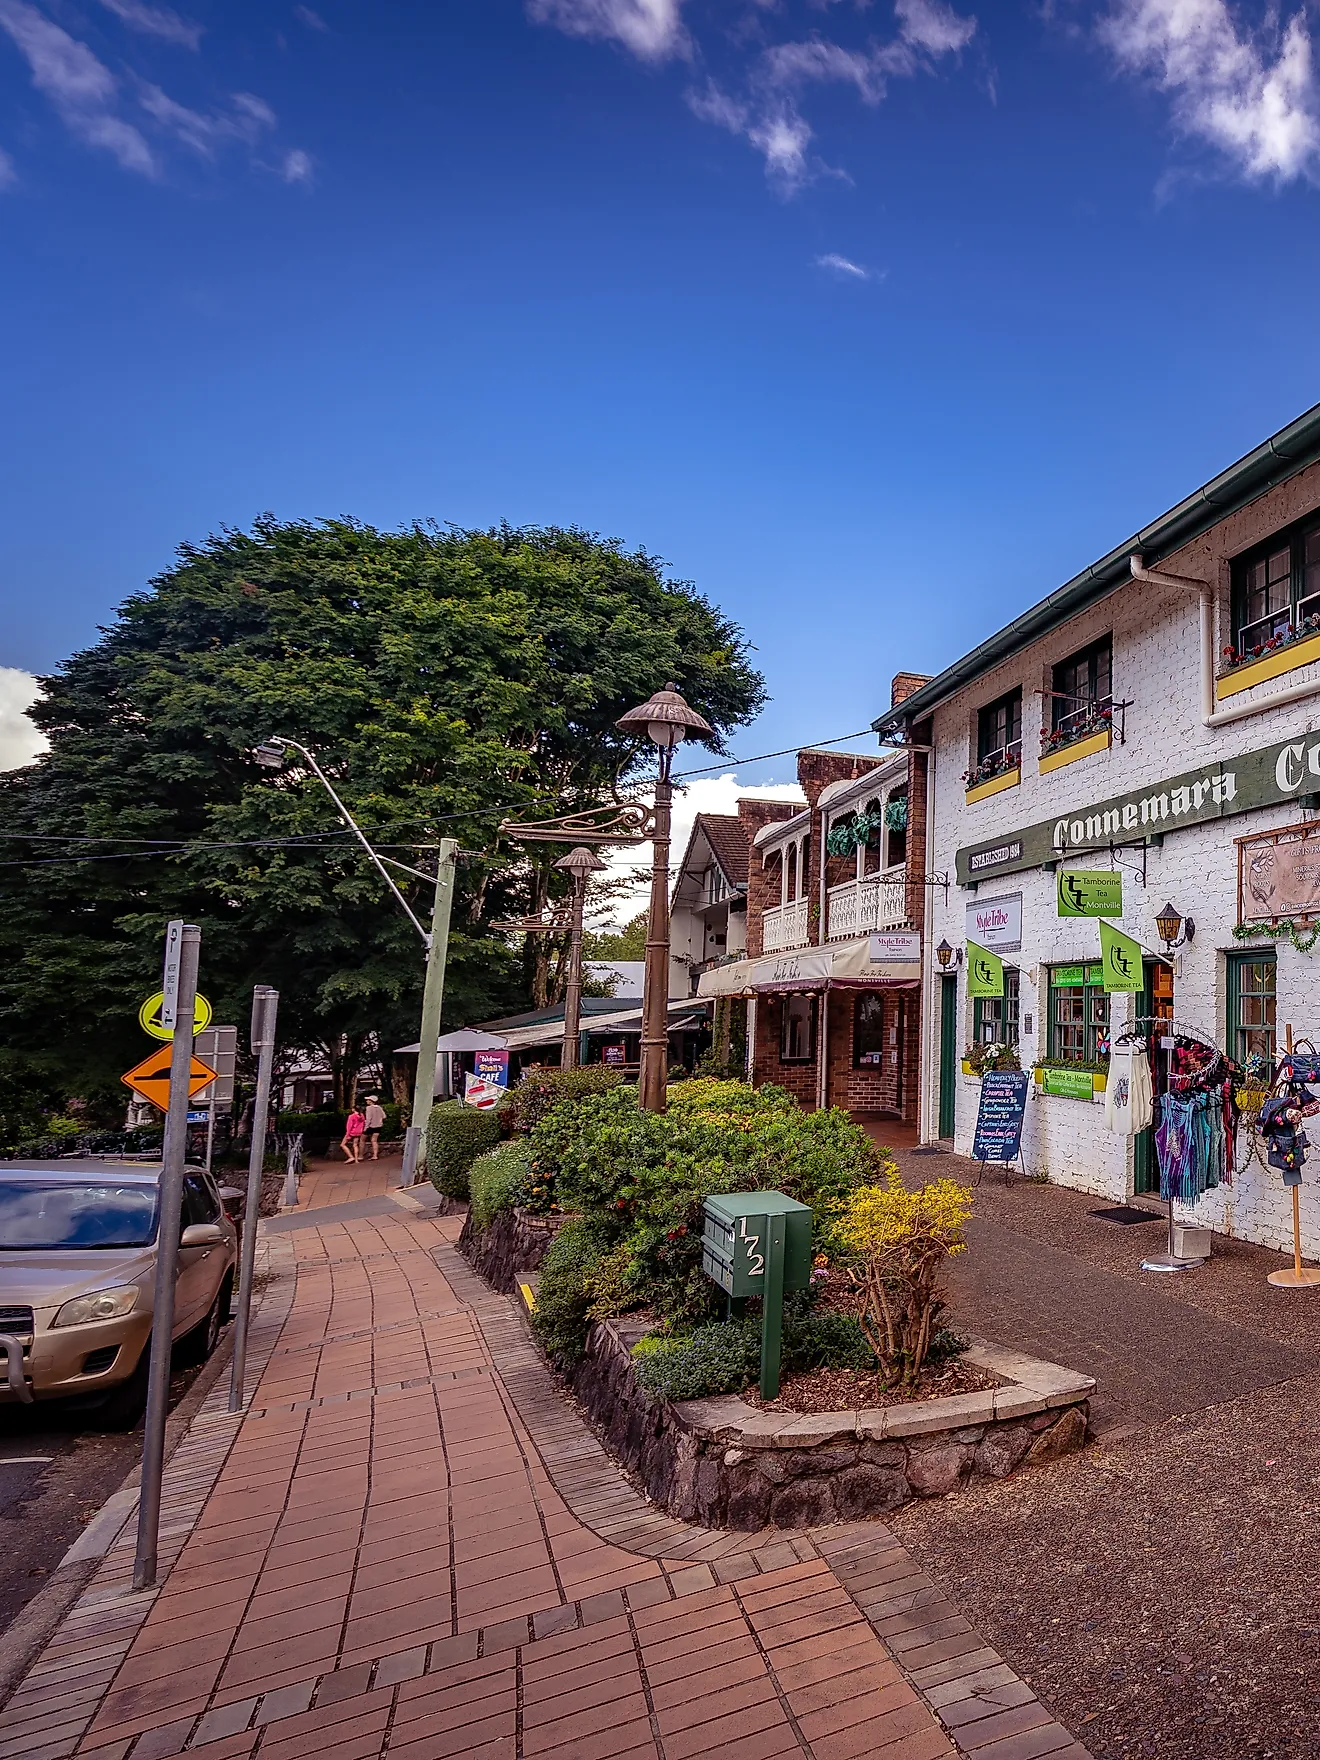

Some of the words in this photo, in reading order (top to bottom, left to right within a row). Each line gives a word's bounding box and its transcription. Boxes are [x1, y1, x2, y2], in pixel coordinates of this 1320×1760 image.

[1053, 772, 1239, 855] Connemara
[1082, 877, 1120, 886] Tamborine
[1086, 901, 1121, 909] Montville
[480, 1072, 500, 1082] CAFÉ
[739, 1216, 765, 1276] 172
